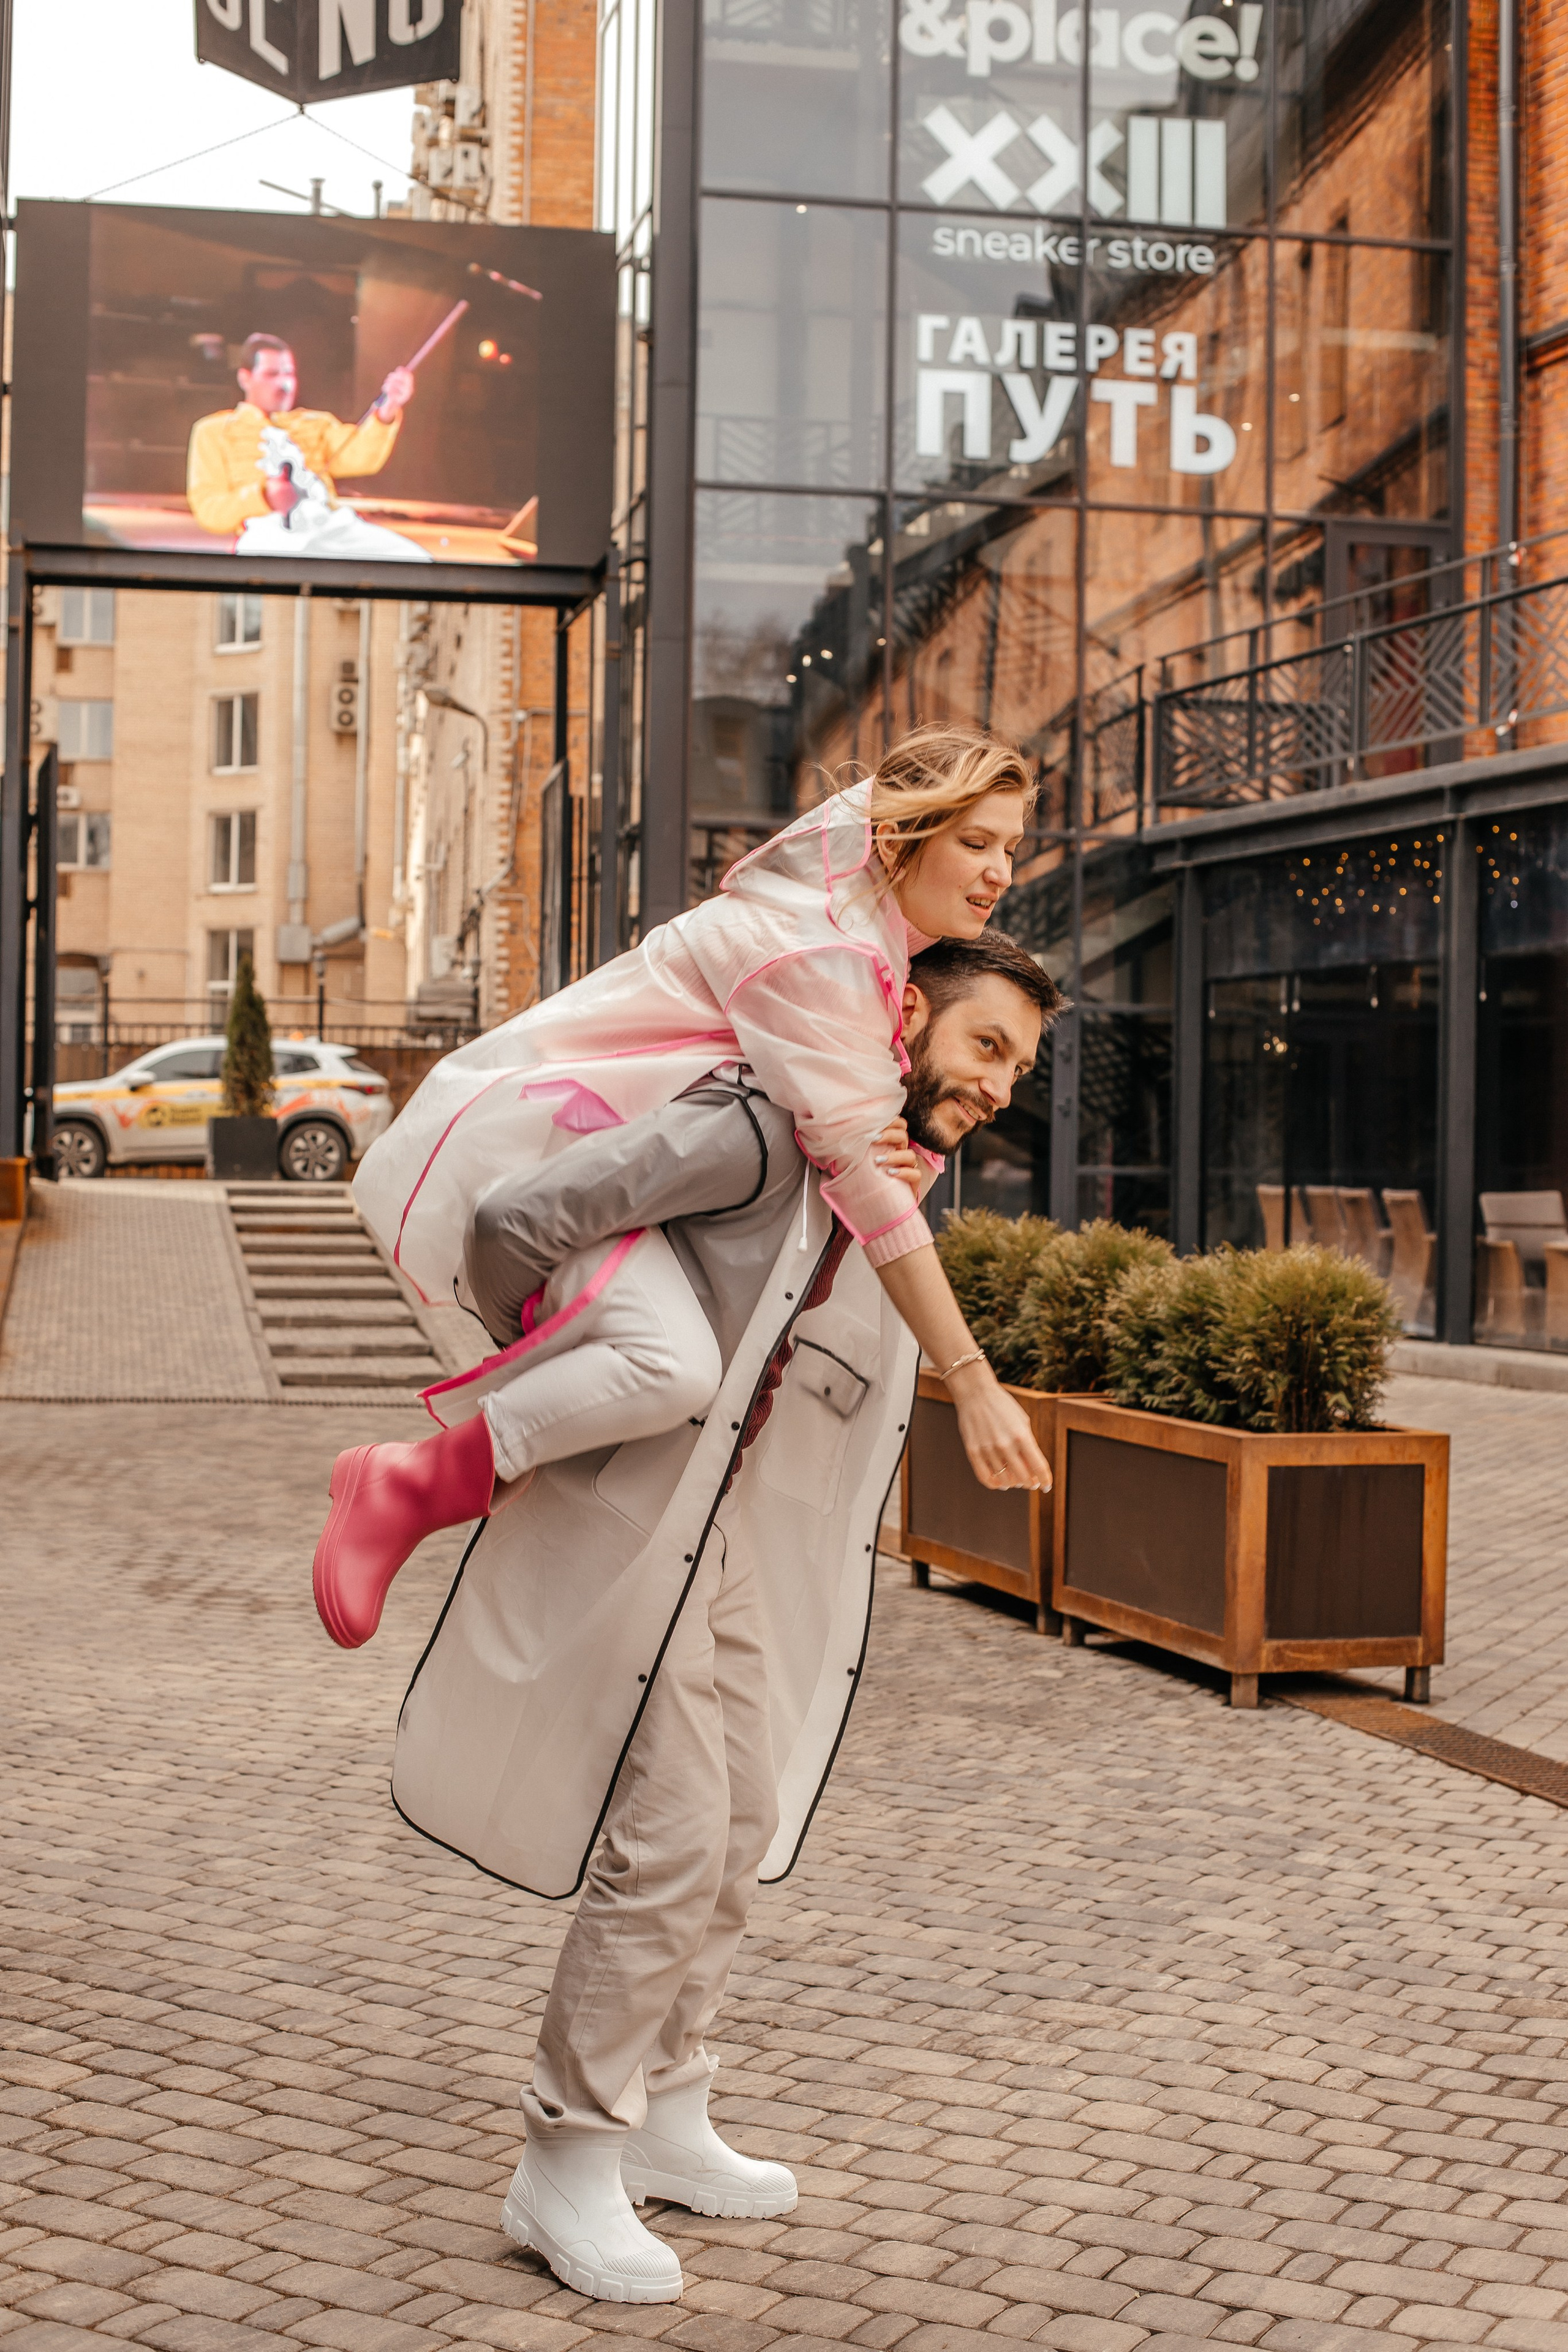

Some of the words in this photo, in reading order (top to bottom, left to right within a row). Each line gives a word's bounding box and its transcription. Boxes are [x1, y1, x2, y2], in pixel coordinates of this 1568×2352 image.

[898, 0, 1263, 81] &place!
[933, 225, 1100, 266] sneaker
[1107, 235, 1216, 274] store
[919, 314, 1197, 380] ГАЛЕРЕЯ
[919, 369, 1237, 475] ПУТЬ
